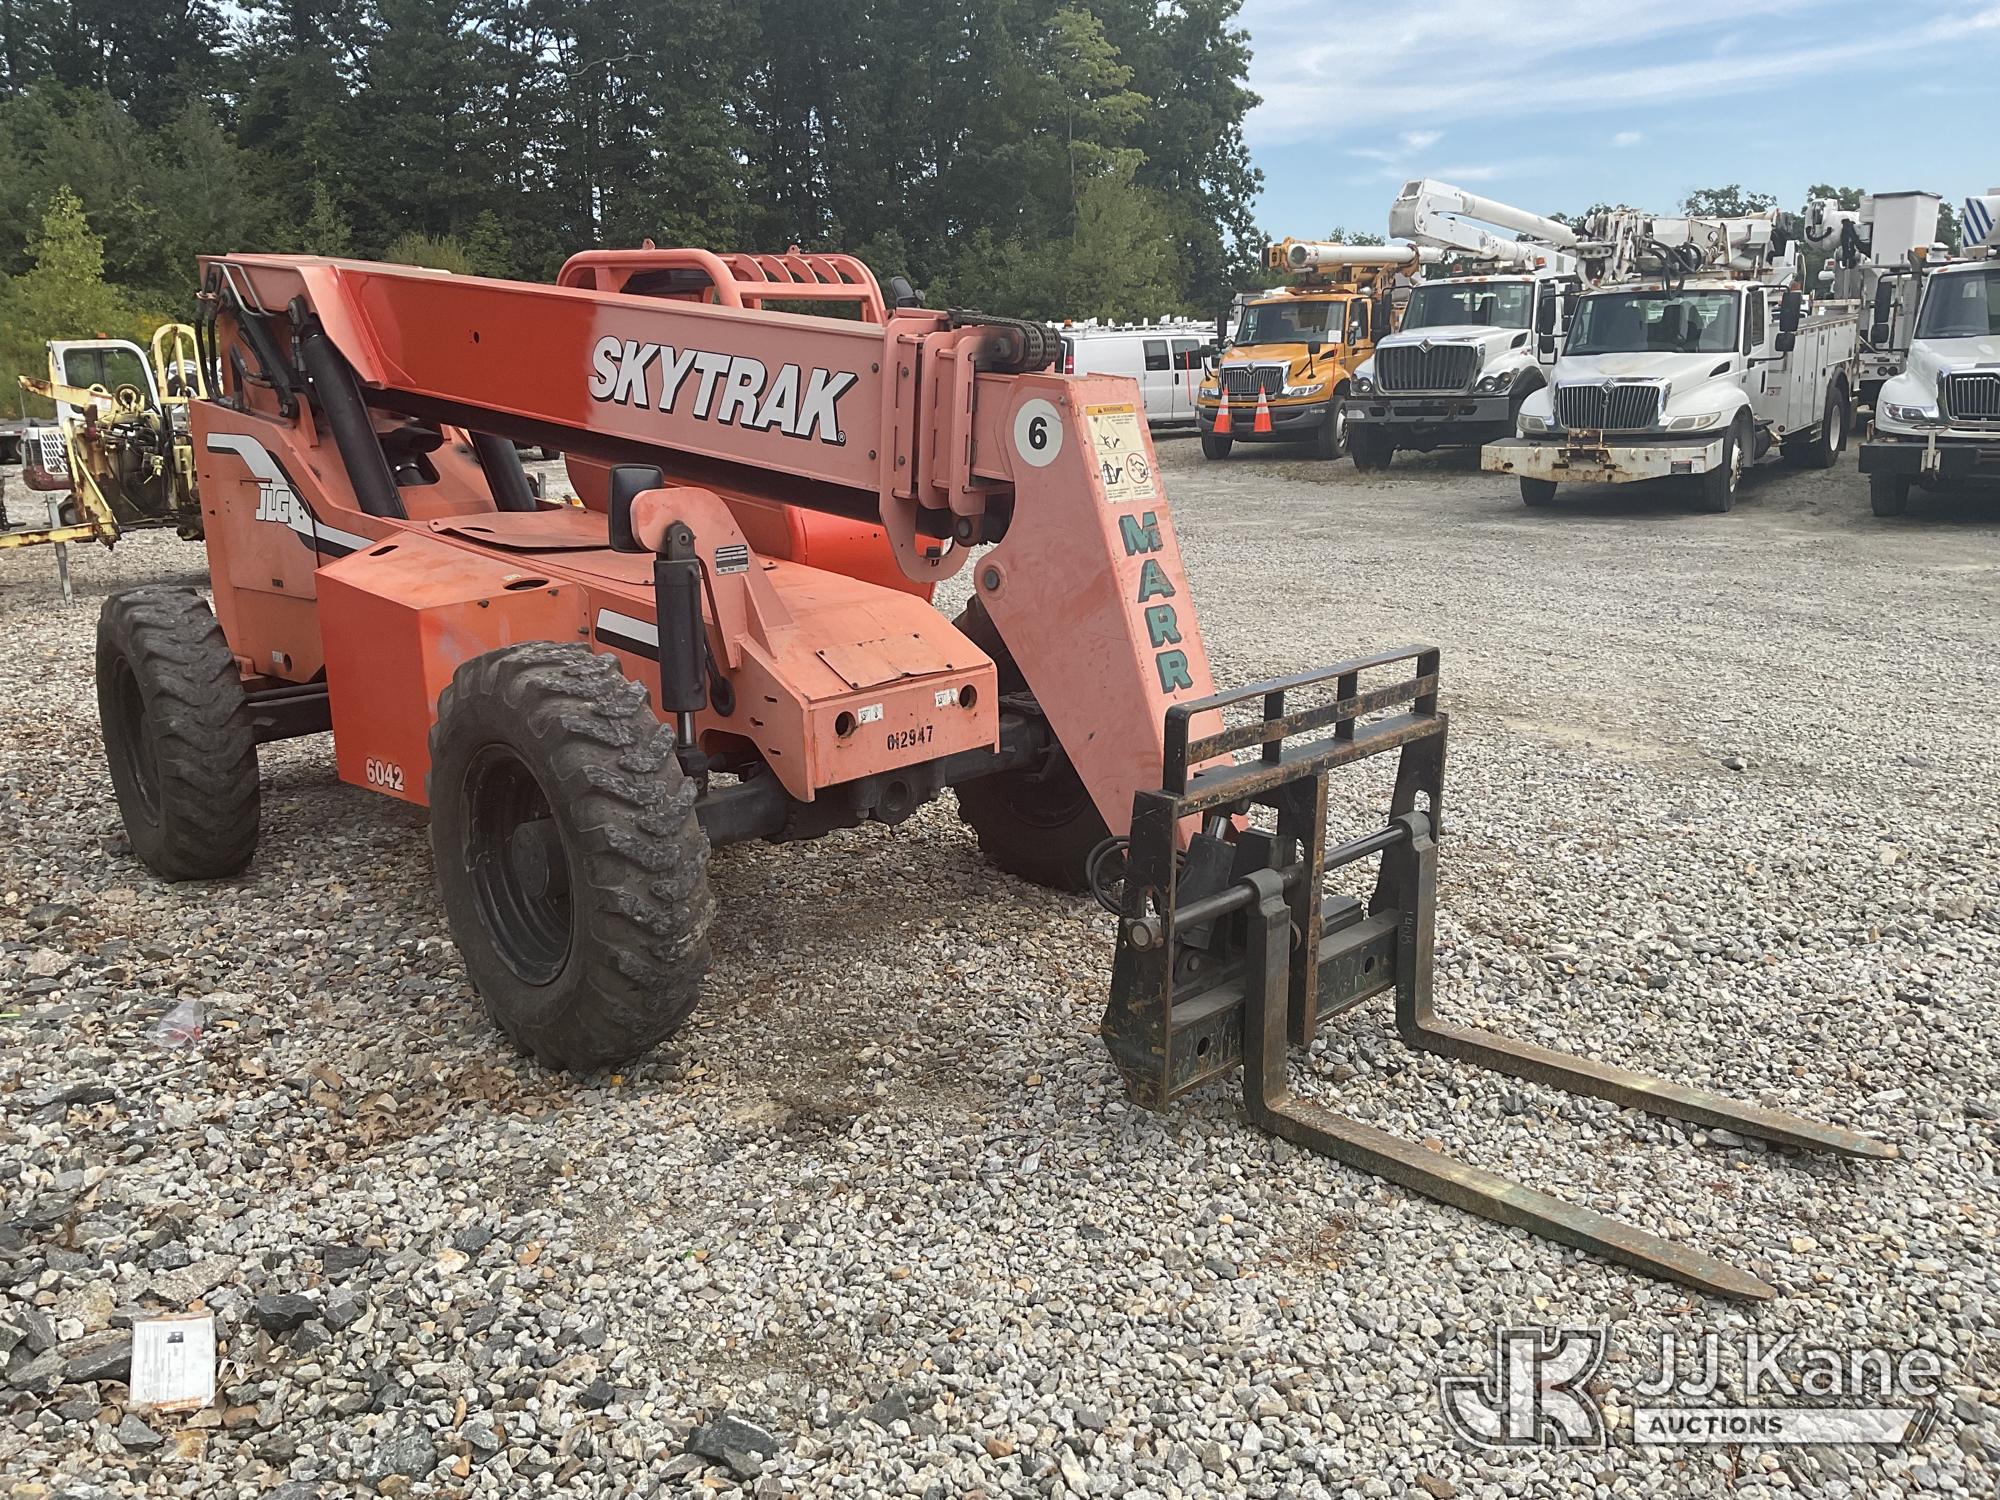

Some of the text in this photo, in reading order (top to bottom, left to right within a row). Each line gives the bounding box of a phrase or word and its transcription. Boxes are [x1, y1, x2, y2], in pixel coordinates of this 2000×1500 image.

[1028, 416, 1048, 450] 6
[255, 486, 291, 523] JLG
[1118, 510, 1194, 695] MARR
[365, 756, 405, 792] 6042
